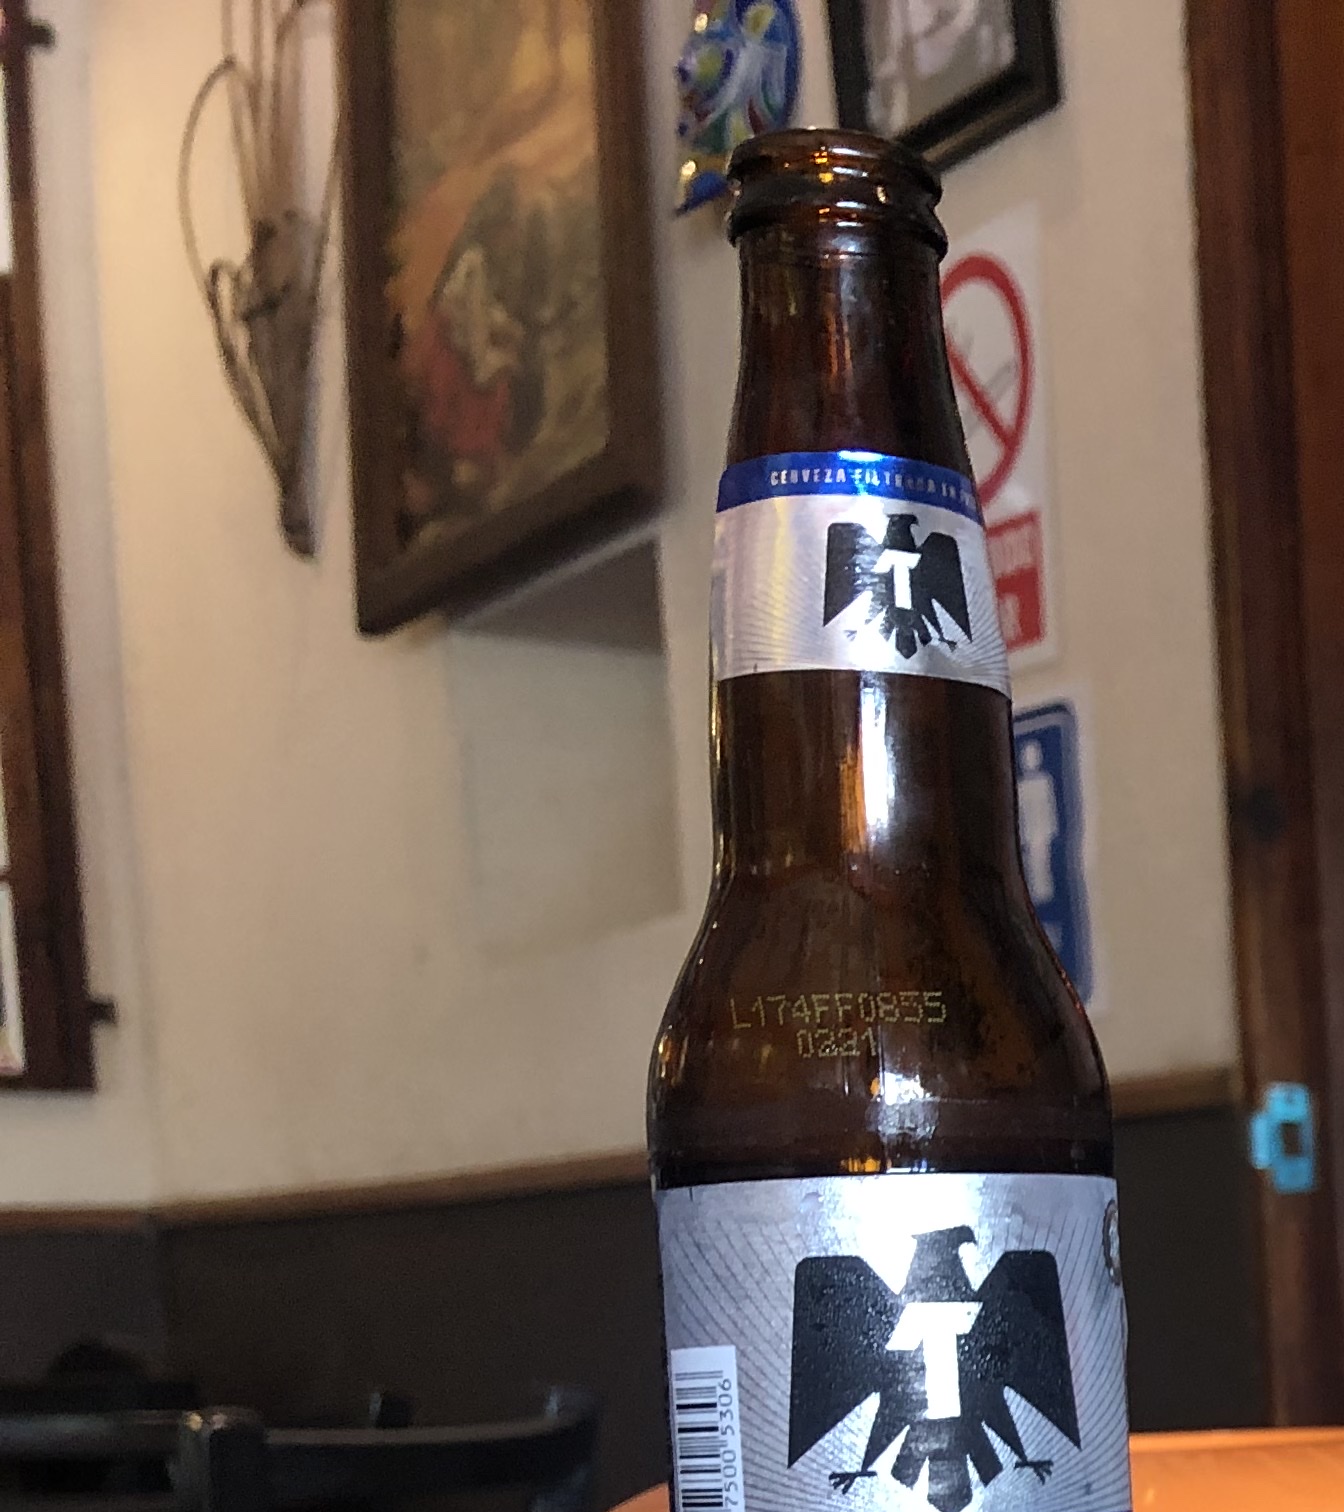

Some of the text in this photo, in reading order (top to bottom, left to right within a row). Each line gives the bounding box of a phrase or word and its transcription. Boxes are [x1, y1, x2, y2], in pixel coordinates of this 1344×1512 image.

[871, 548, 922, 610] T
[884, 1301, 984, 1421] T
[717, 1377, 739, 1509] 7500 5306
